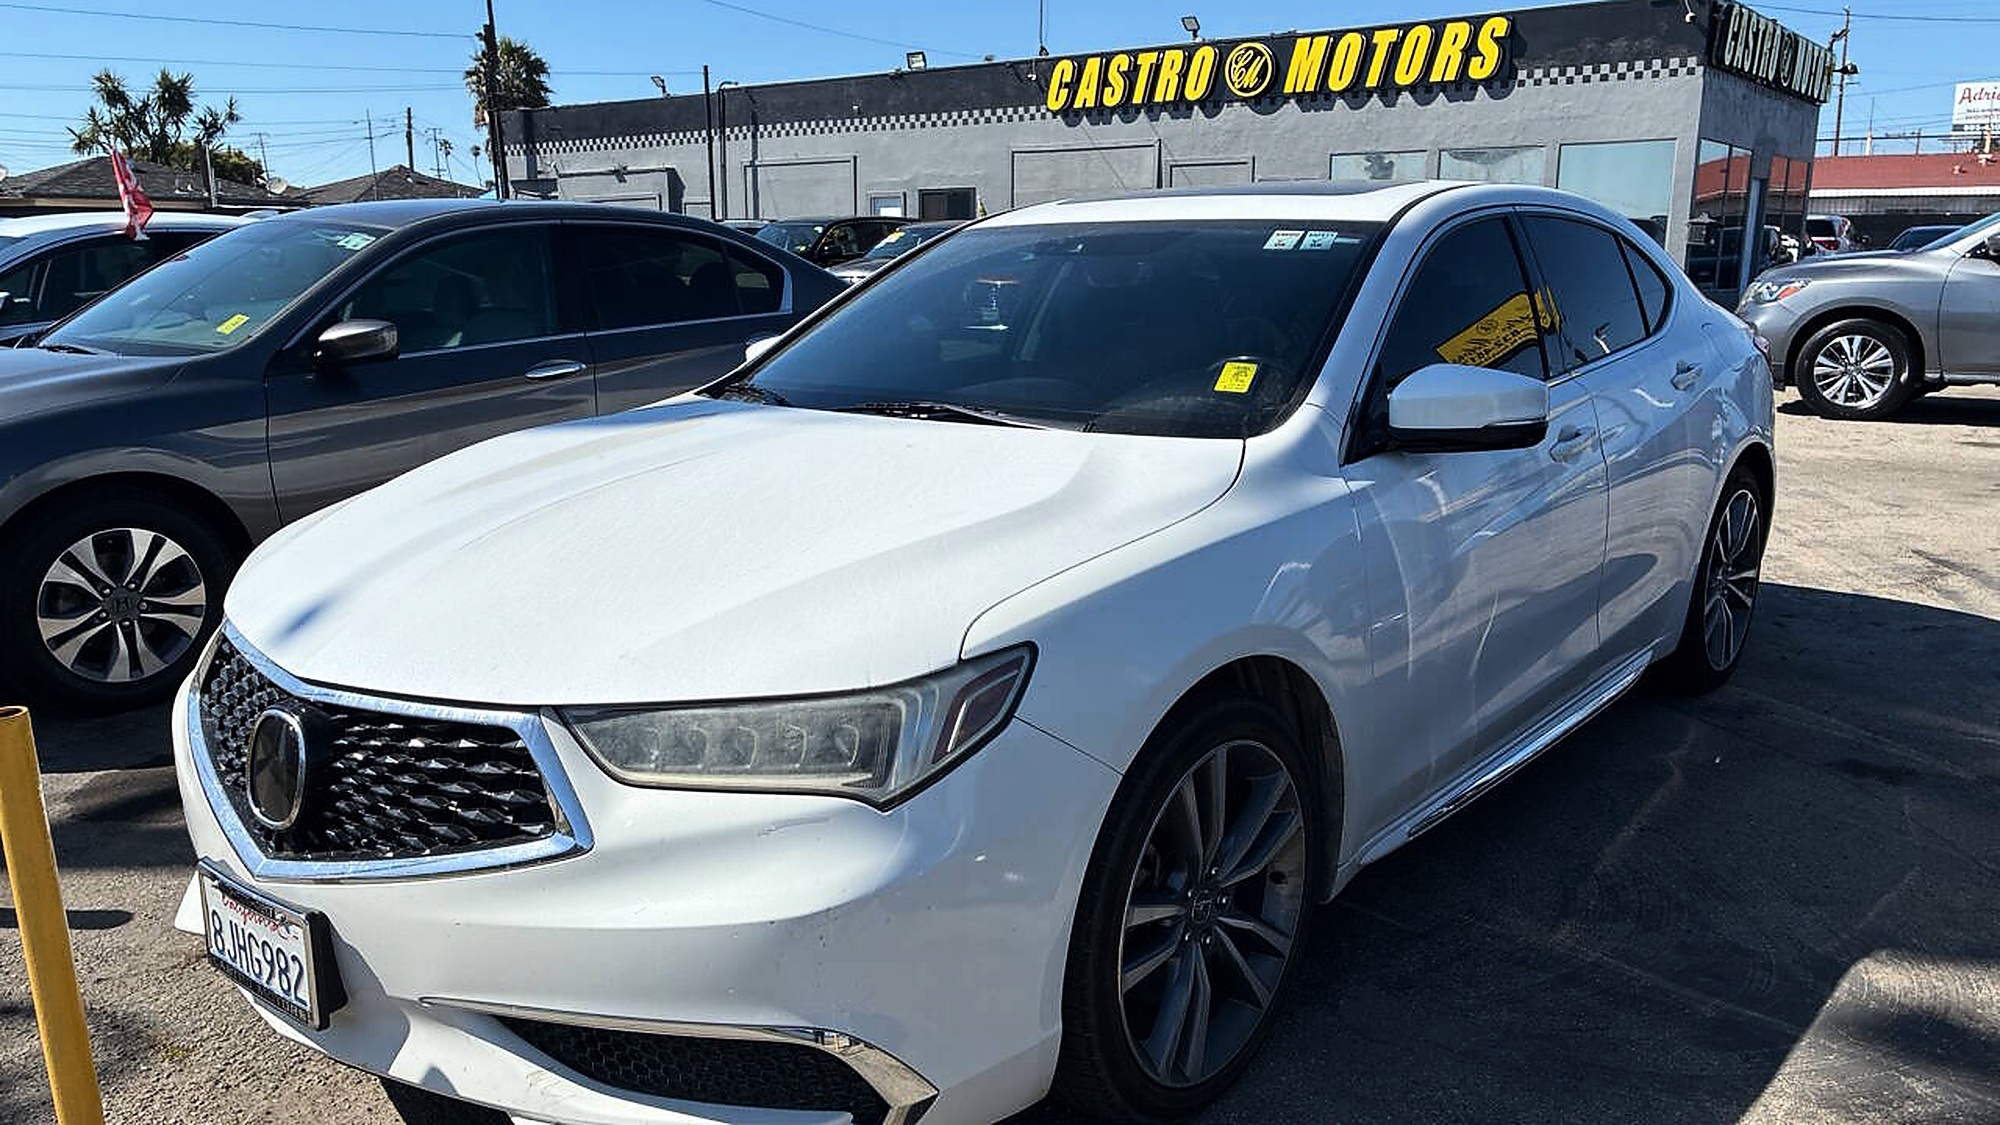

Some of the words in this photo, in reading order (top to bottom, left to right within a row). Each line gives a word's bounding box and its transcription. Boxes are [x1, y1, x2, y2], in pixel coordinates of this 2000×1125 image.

[1047, 46, 1219, 111] CASTRO
[1284, 17, 1509, 94] MOTORS
[1724, 3, 1782, 82] CASTRO
[211, 909, 309, 1006] 8JHG982
